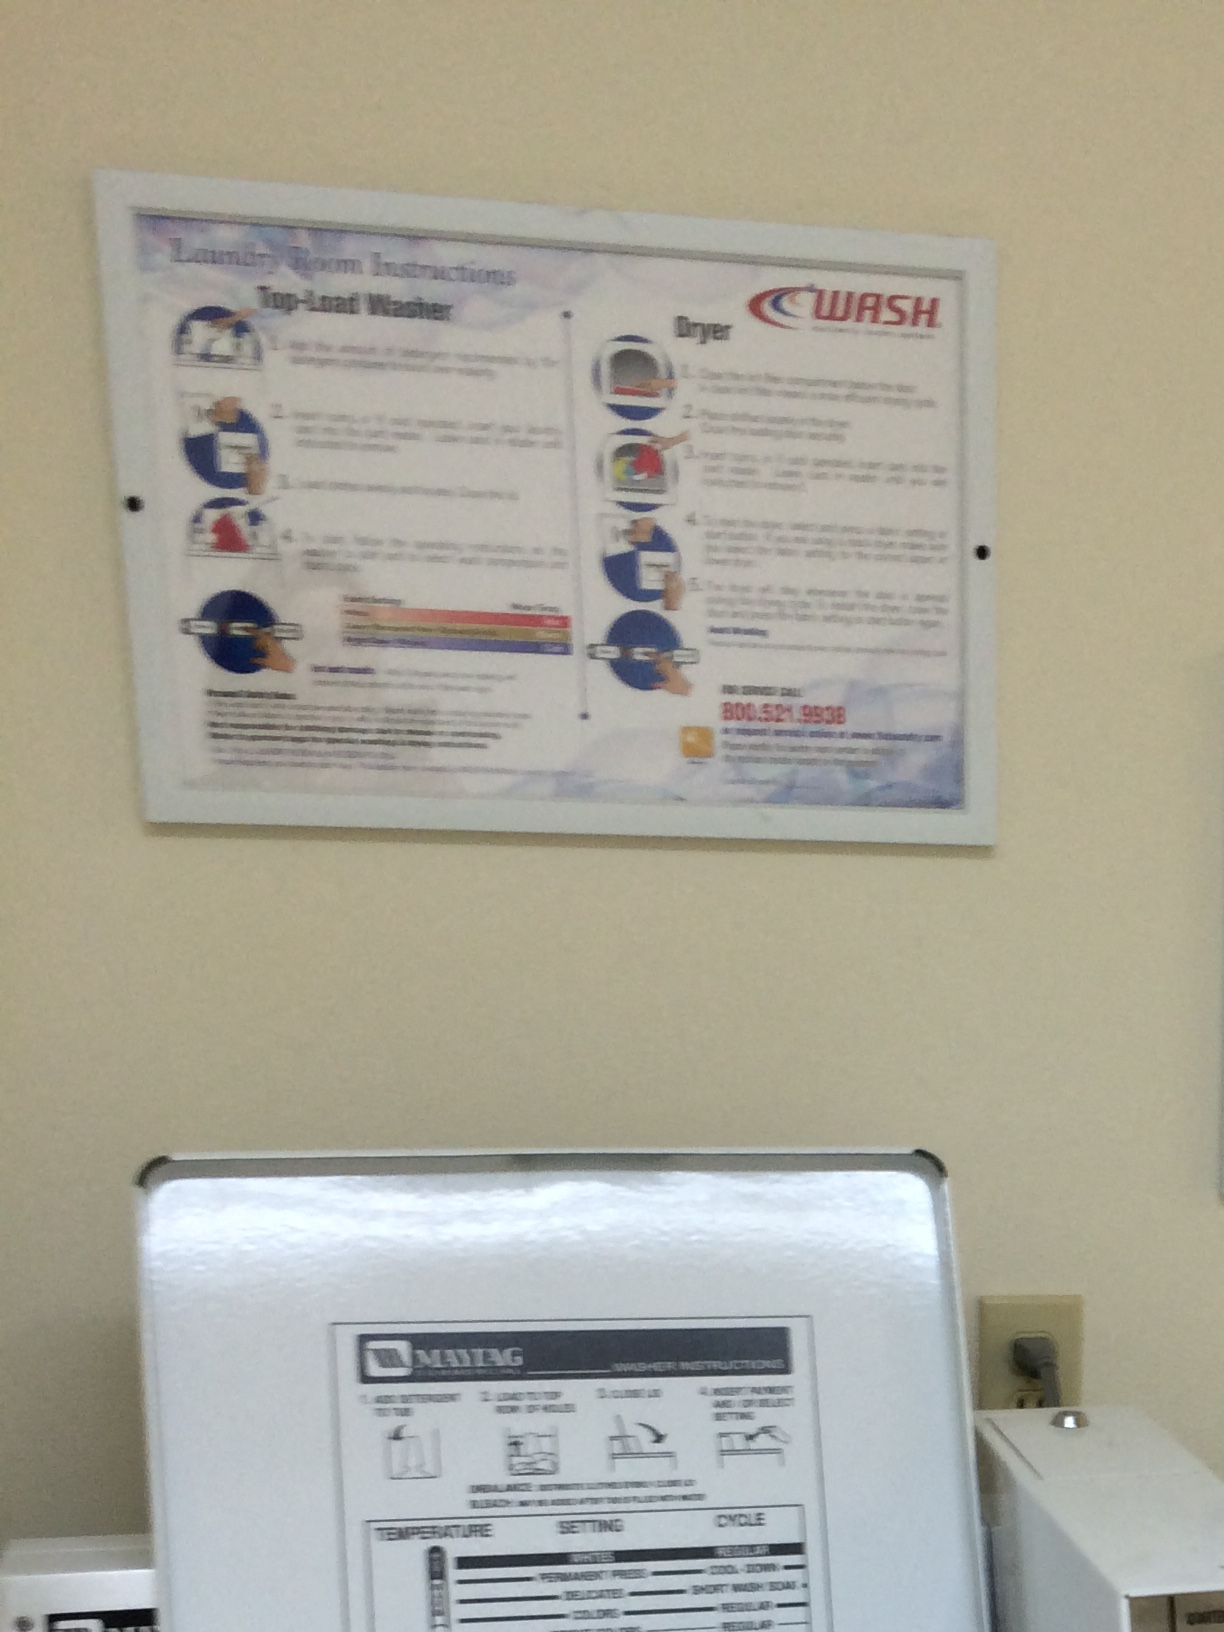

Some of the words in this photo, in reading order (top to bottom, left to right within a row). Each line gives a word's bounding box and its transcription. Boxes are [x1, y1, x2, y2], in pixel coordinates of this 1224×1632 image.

[288, 245, 363, 276] Room
[370, 250, 516, 286] Instructions
[256, 284, 361, 315] Top-Load
[367, 291, 454, 321] Washer
[812, 288, 939, 329] WASH
[674, 314, 733, 345] Dryer
[413, 1346, 524, 1368] MAYTAG
[374, 1523, 494, 1541] TEMPERATURE
[557, 1518, 625, 1535] SETTING
[715, 1513, 766, 1528] CYCLE
